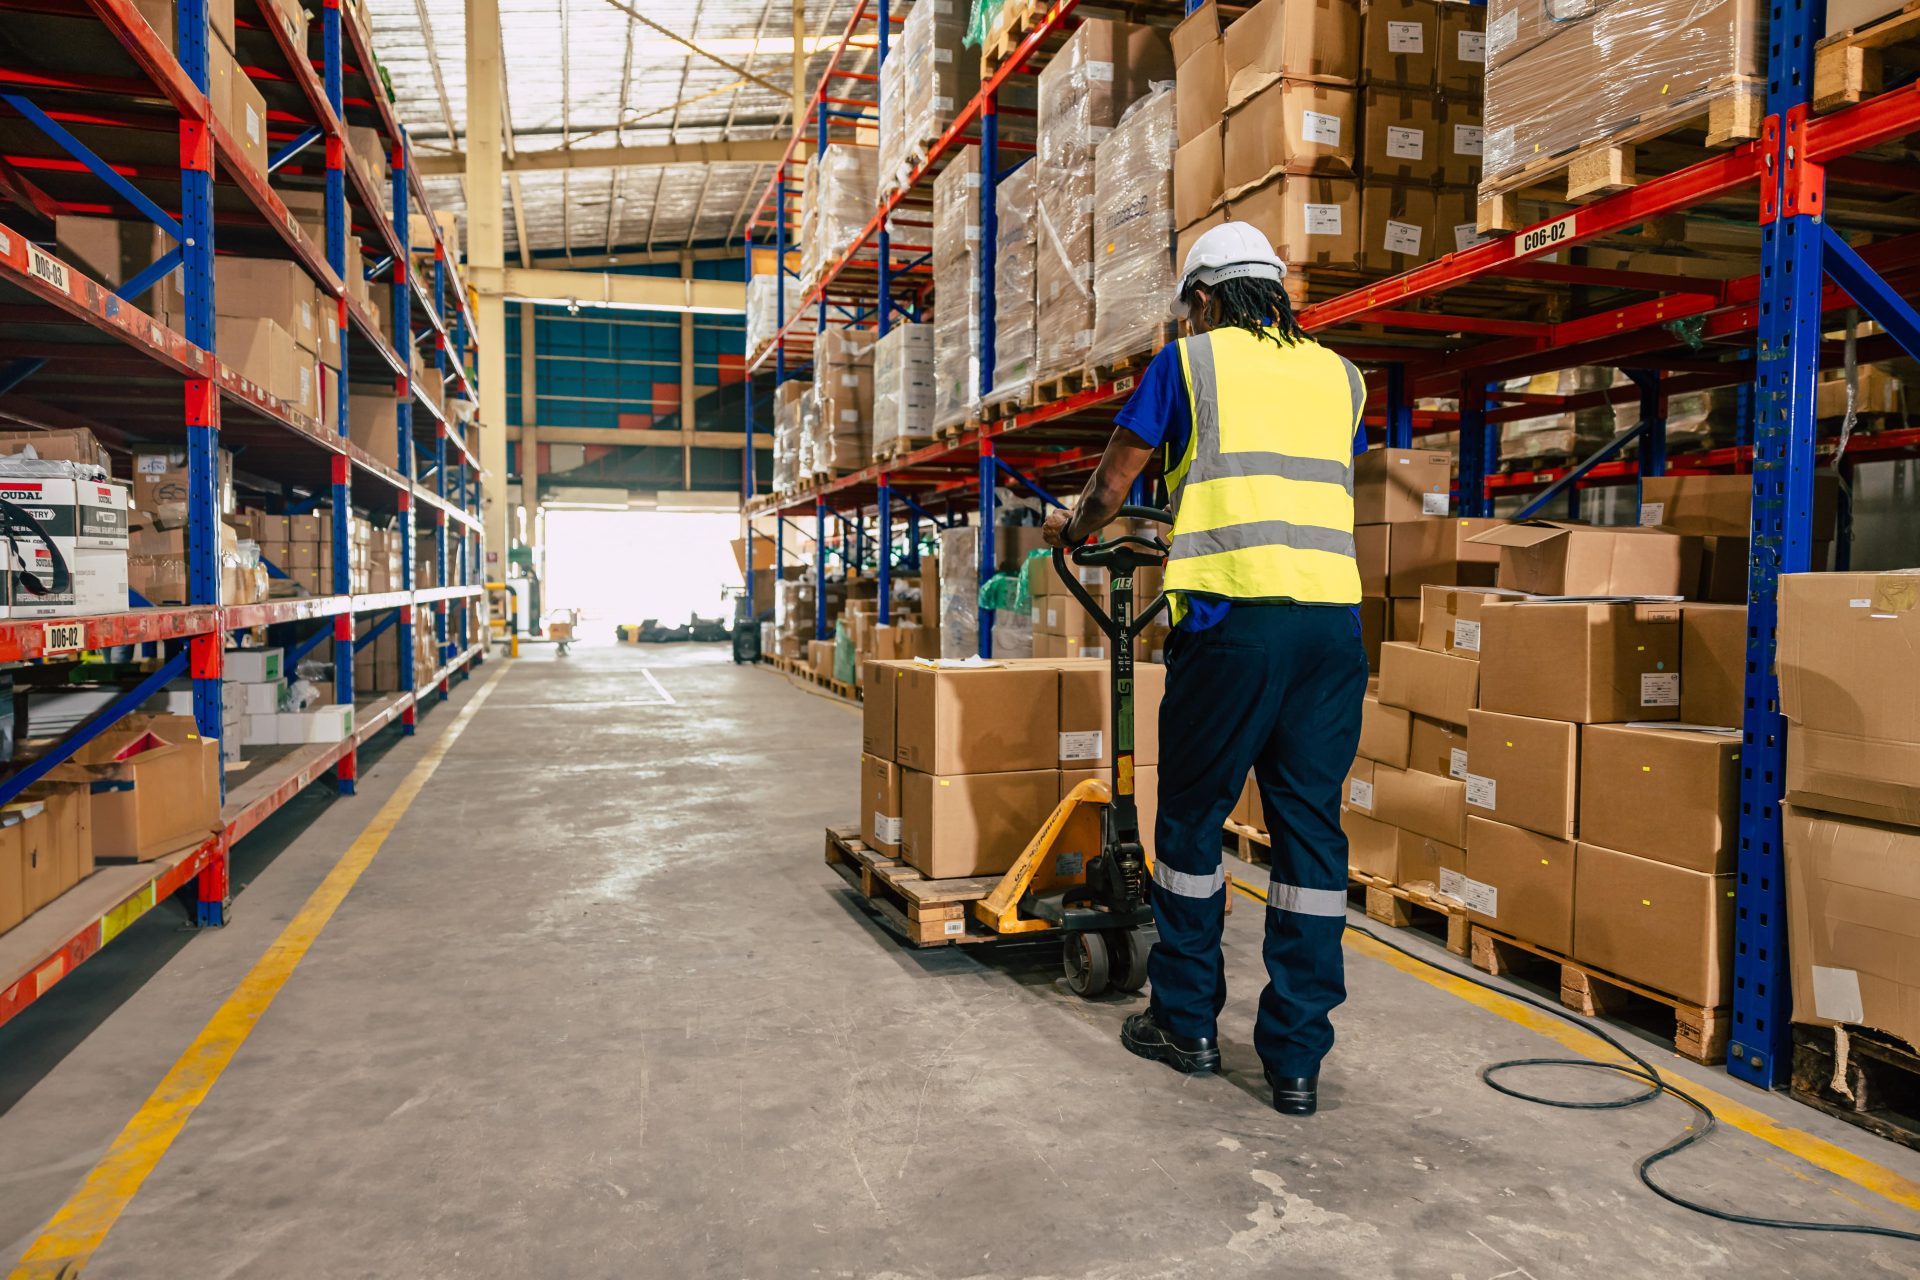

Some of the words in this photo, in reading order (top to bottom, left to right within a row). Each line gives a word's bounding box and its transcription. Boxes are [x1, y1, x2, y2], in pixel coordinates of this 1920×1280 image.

[1524, 222, 1566, 251] C06-02
[35, 253, 63, 287] D06-03
[0, 491, 42, 500] OUDAL
[26, 510, 49, 518] STRY
[51, 627, 78, 649] D06-02
